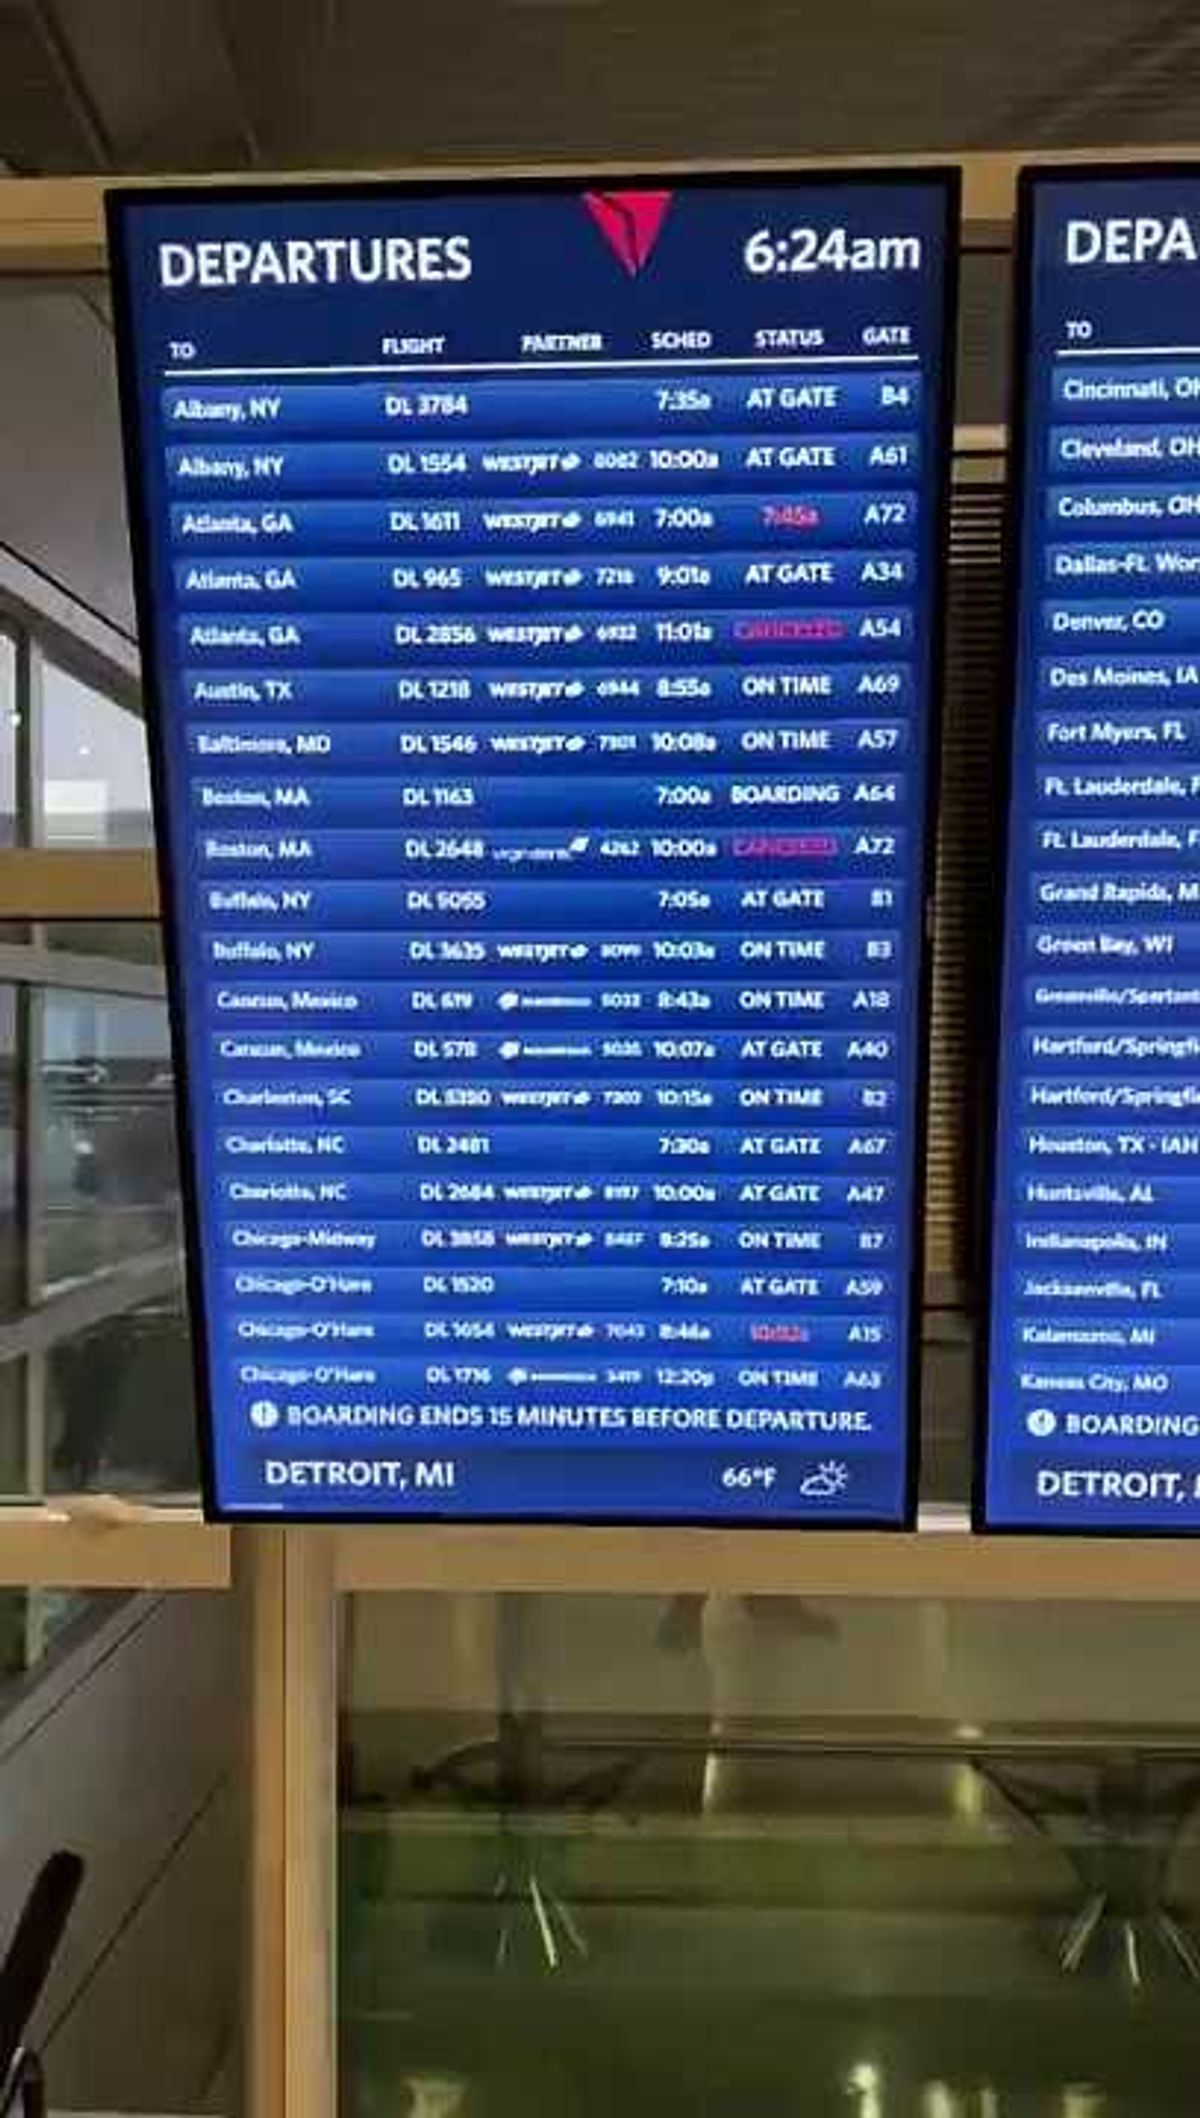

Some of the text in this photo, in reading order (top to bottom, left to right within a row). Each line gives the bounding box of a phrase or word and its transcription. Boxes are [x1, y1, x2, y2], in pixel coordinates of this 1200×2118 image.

[744, 228, 921, 273] 6:24am
[1066, 217, 1198, 264] DEPA
[159, 235, 472, 287] DEPARTURES
[651, 331, 712, 349] SCHED
[755, 329, 824, 348] STATUS
[862, 326, 910, 346] GATE
[1066, 321, 1092, 339] TO
[169, 342, 196, 359] TO
[382, 336, 445, 354] FLIGHT
[521, 333, 602, 352] PARTNER
[747, 386, 838, 408] AT GATE
[882, 386, 909, 405] B4
[1063, 379, 1169, 400] Cincinnati,
[173, 397, 281, 421] Albany, NY
[385, 395, 412, 416] DL
[745, 447, 835, 468] AT GATE
[870, 444, 909, 465] A61
[1060, 438, 1163, 459] Cleveland,
[177, 456, 283, 480] Albany, NY
[388, 453, 415, 474] DL
[650, 449, 719, 469] 10:00a
[864, 503, 906, 524] A72
[1058, 497, 1163, 517] Columbus,
[182, 513, 293, 534] Atlanta, GA
[390, 512, 419, 531] DL
[655, 507, 713, 528] 7:00a
[186, 568, 297, 590] Atlanta, GA
[392, 568, 462, 588] DL 965
[657, 565, 711, 585] 9:01a
[745, 562, 834, 583] AT GATE
[861, 561, 904, 581] A34
[860, 618, 901, 638] A54
[1052, 609, 1165, 631] Denver, CO
[190, 626, 300, 646] Atlanta, GA
[395, 624, 422, 644] DL
[656, 621, 712, 642] 11:01a
[742, 675, 831, 696] ON TIME
[857, 674, 900, 694] A69
[1050, 665, 1200, 687] Des Moines, IA
[194, 680, 292, 701] Austin, TX
[399, 679, 471, 699] DL 1218
[656, 677, 711, 697] 8:55a
[651, 732, 717, 752] 10:08a
[741, 730, 831, 751] ON TIME
[858, 729, 898, 748] A57
[1047, 721, 1186, 744] Fort Myers, FL
[297, 735, 331, 753] MD
[400, 734, 477, 753] DL 1546
[656, 786, 712, 805] 7:00a
[730, 784, 840, 804] BOARDING
[853, 783, 895, 801] A64
[1073, 776, 1186, 796] Lauderdale,
[276, 787, 310, 808] MA
[403, 788, 474, 806] DL 1163
[279, 840, 312, 857] MA
[405, 839, 432, 858] DL
[651, 838, 717, 857] 10:00a
[854, 836, 895, 854] A72
[1071, 829, 1181, 849] Lauderdale,
[283, 891, 311, 908] NY
[407, 891, 433, 909] DL
[658, 890, 711, 908] 7:05a
[741, 889, 824, 907] AT GATE
[1039, 882, 1173, 904] Grand Rapids,
[286, 942, 314, 958] NY
[410, 941, 434, 959] DL
[740, 940, 825, 959] ON TIME
[1142, 935, 1173, 953] WI
[412, 991, 437, 1009] DL
[739, 990, 825, 1009] ON TIME
[414, 1040, 439, 1057] DL
[653, 1040, 715, 1058] 10:07a
[741, 1039, 822, 1058] AT GATE
[847, 1040, 889, 1058] A40
[416, 1088, 441, 1105] DL
[739, 1088, 823, 1107] ON TIME
[318, 1136, 343, 1153] NC
[740, 1137, 821, 1154] AT GATE
[848, 1137, 887, 1154] A67
[1029, 1134, 1145, 1154] Houston, TX
[320, 1183, 346, 1200] NC
[739, 1184, 820, 1201] AT GATE
[738, 1231, 821, 1248] ON TIME
[741, 1277, 819, 1295] AT GATE
[738, 1369, 818, 1386] ON TIME
[1133, 1374, 1168, 1392] MO
[288, 1404, 872, 1431] BOARDING ENDS 15 MINUTES BEFORE DEPARTURE.
[1067, 1413, 1200, 1436] BOARDING
[266, 1460, 454, 1490] DETROIT, MI
[722, 1467, 776, 1488] 66°F
[1037, 1470, 1185, 1502] DETROIT,
